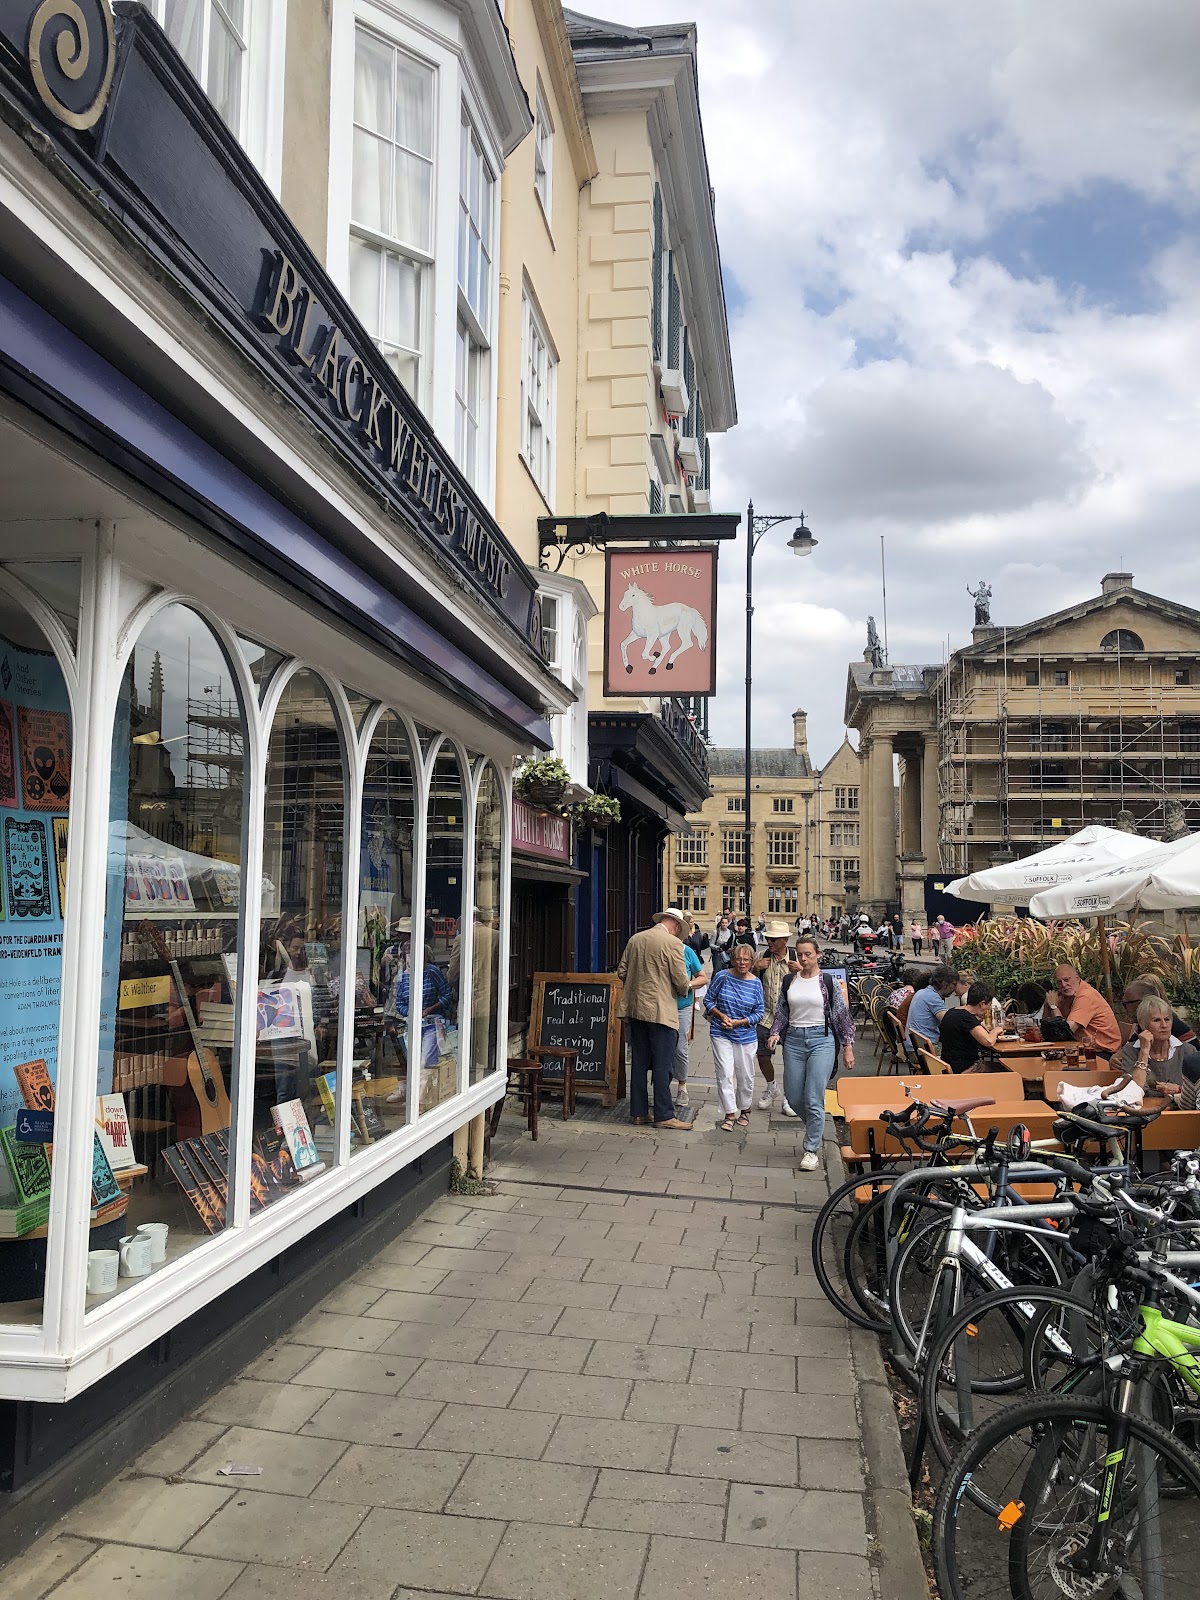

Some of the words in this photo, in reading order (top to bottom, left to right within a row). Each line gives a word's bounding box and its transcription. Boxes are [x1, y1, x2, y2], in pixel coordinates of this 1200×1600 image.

[264, 249, 458, 537] BLACKWELL'S
[460, 522, 512, 600] MUSIC
[620, 563, 660, 580] WHITE
[664, 562, 702, 580] HORSE
[16, 662, 29, 674] And
[16, 673, 37, 686] Other
[16, 684, 42, 697] Stories
[514, 803, 540, 846] WHITE
[543, 815, 564, 852] HORSE
[1076, 897, 1097, 907] SUFFOLK
[3, 935, 12, 944] FOR
[14, 935, 23, 944] THE
[23, 934, 53, 944] GUARDIAN
[32, 975, 61, 986] delibera
[37, 987, 44, 997] of
[123, 984, 130, 997] &
[131, 982, 157, 995] Walther
[548, 988, 607, 1006] Traditional
[546, 1009, 565, 1025] real
[568, 1009, 584, 1024] ale
[590, 1007, 607, 1030] pub
[9, 1025, 24, 1036] about
[26, 1023, 57, 1033] innocence,
[22, 1037, 34, 1047] drug
[549, 1034, 595, 1056] Serving
[543, 1057, 566, 1071] ocal
[575, 1055, 602, 1072] beer
[105, 1105, 124, 1113] down
[105, 1121, 127, 1136] RABBIT
[112, 1134, 128, 1148] HOLE
